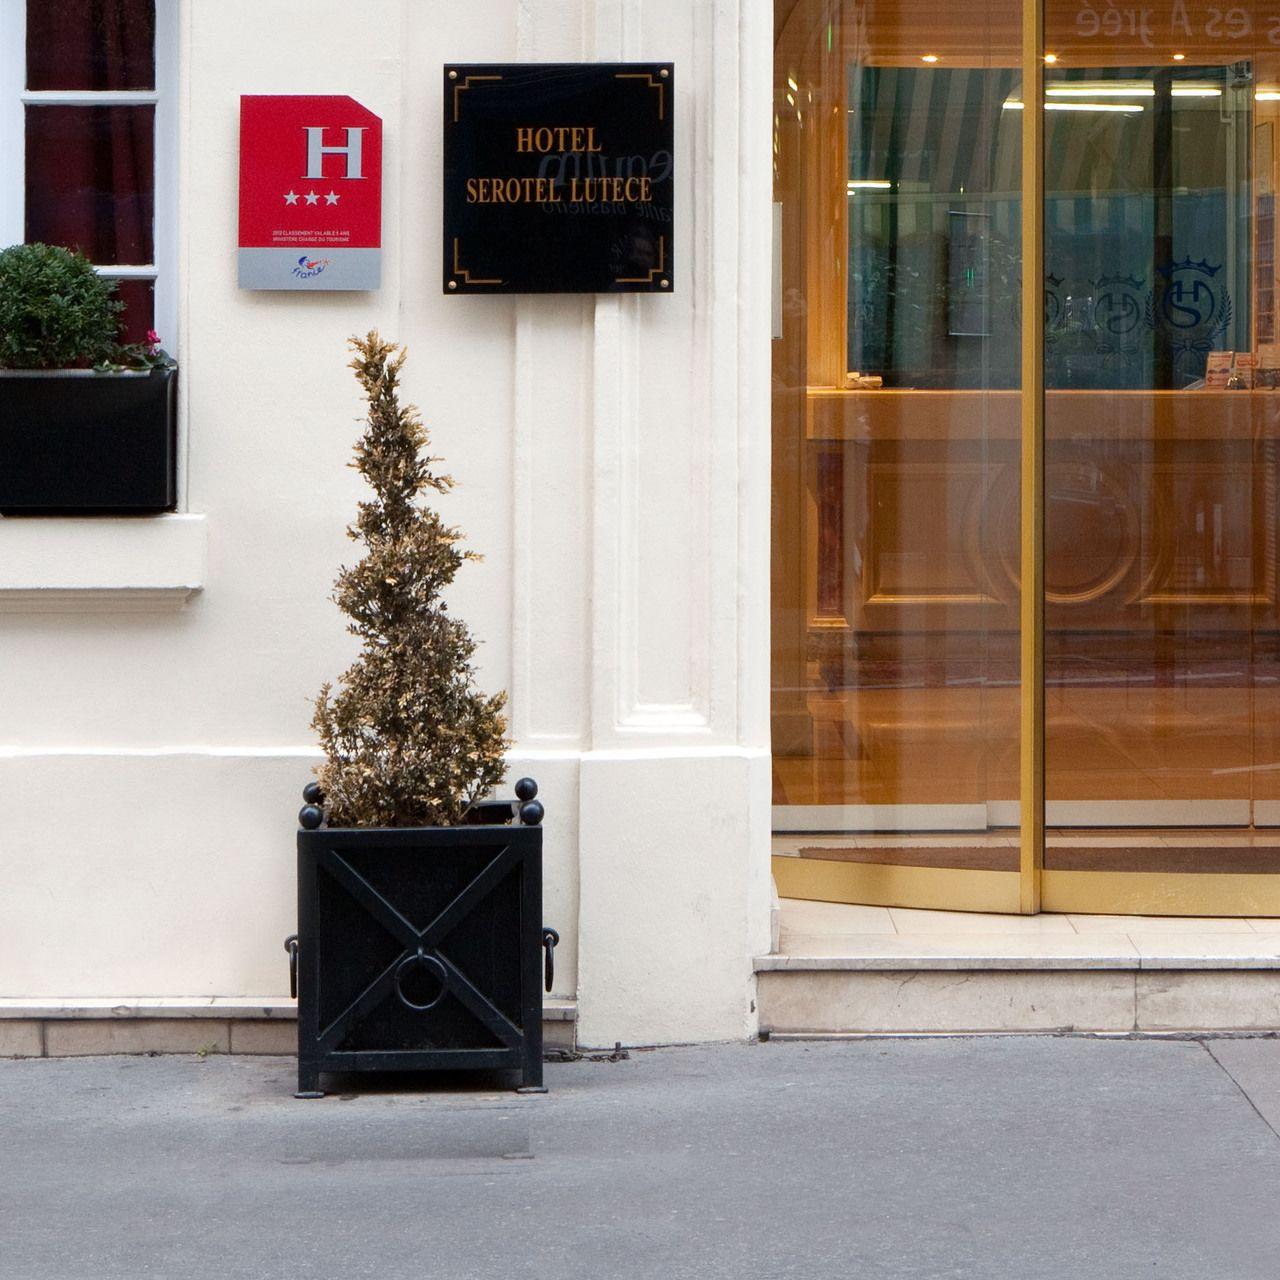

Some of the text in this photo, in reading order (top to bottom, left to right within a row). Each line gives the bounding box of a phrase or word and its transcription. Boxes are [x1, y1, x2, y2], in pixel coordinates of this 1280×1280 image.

[516, 127, 602, 152] HOTEL
[300, 127, 369, 180] H
[466, 177, 652, 203] SEROTEL LUTECE
